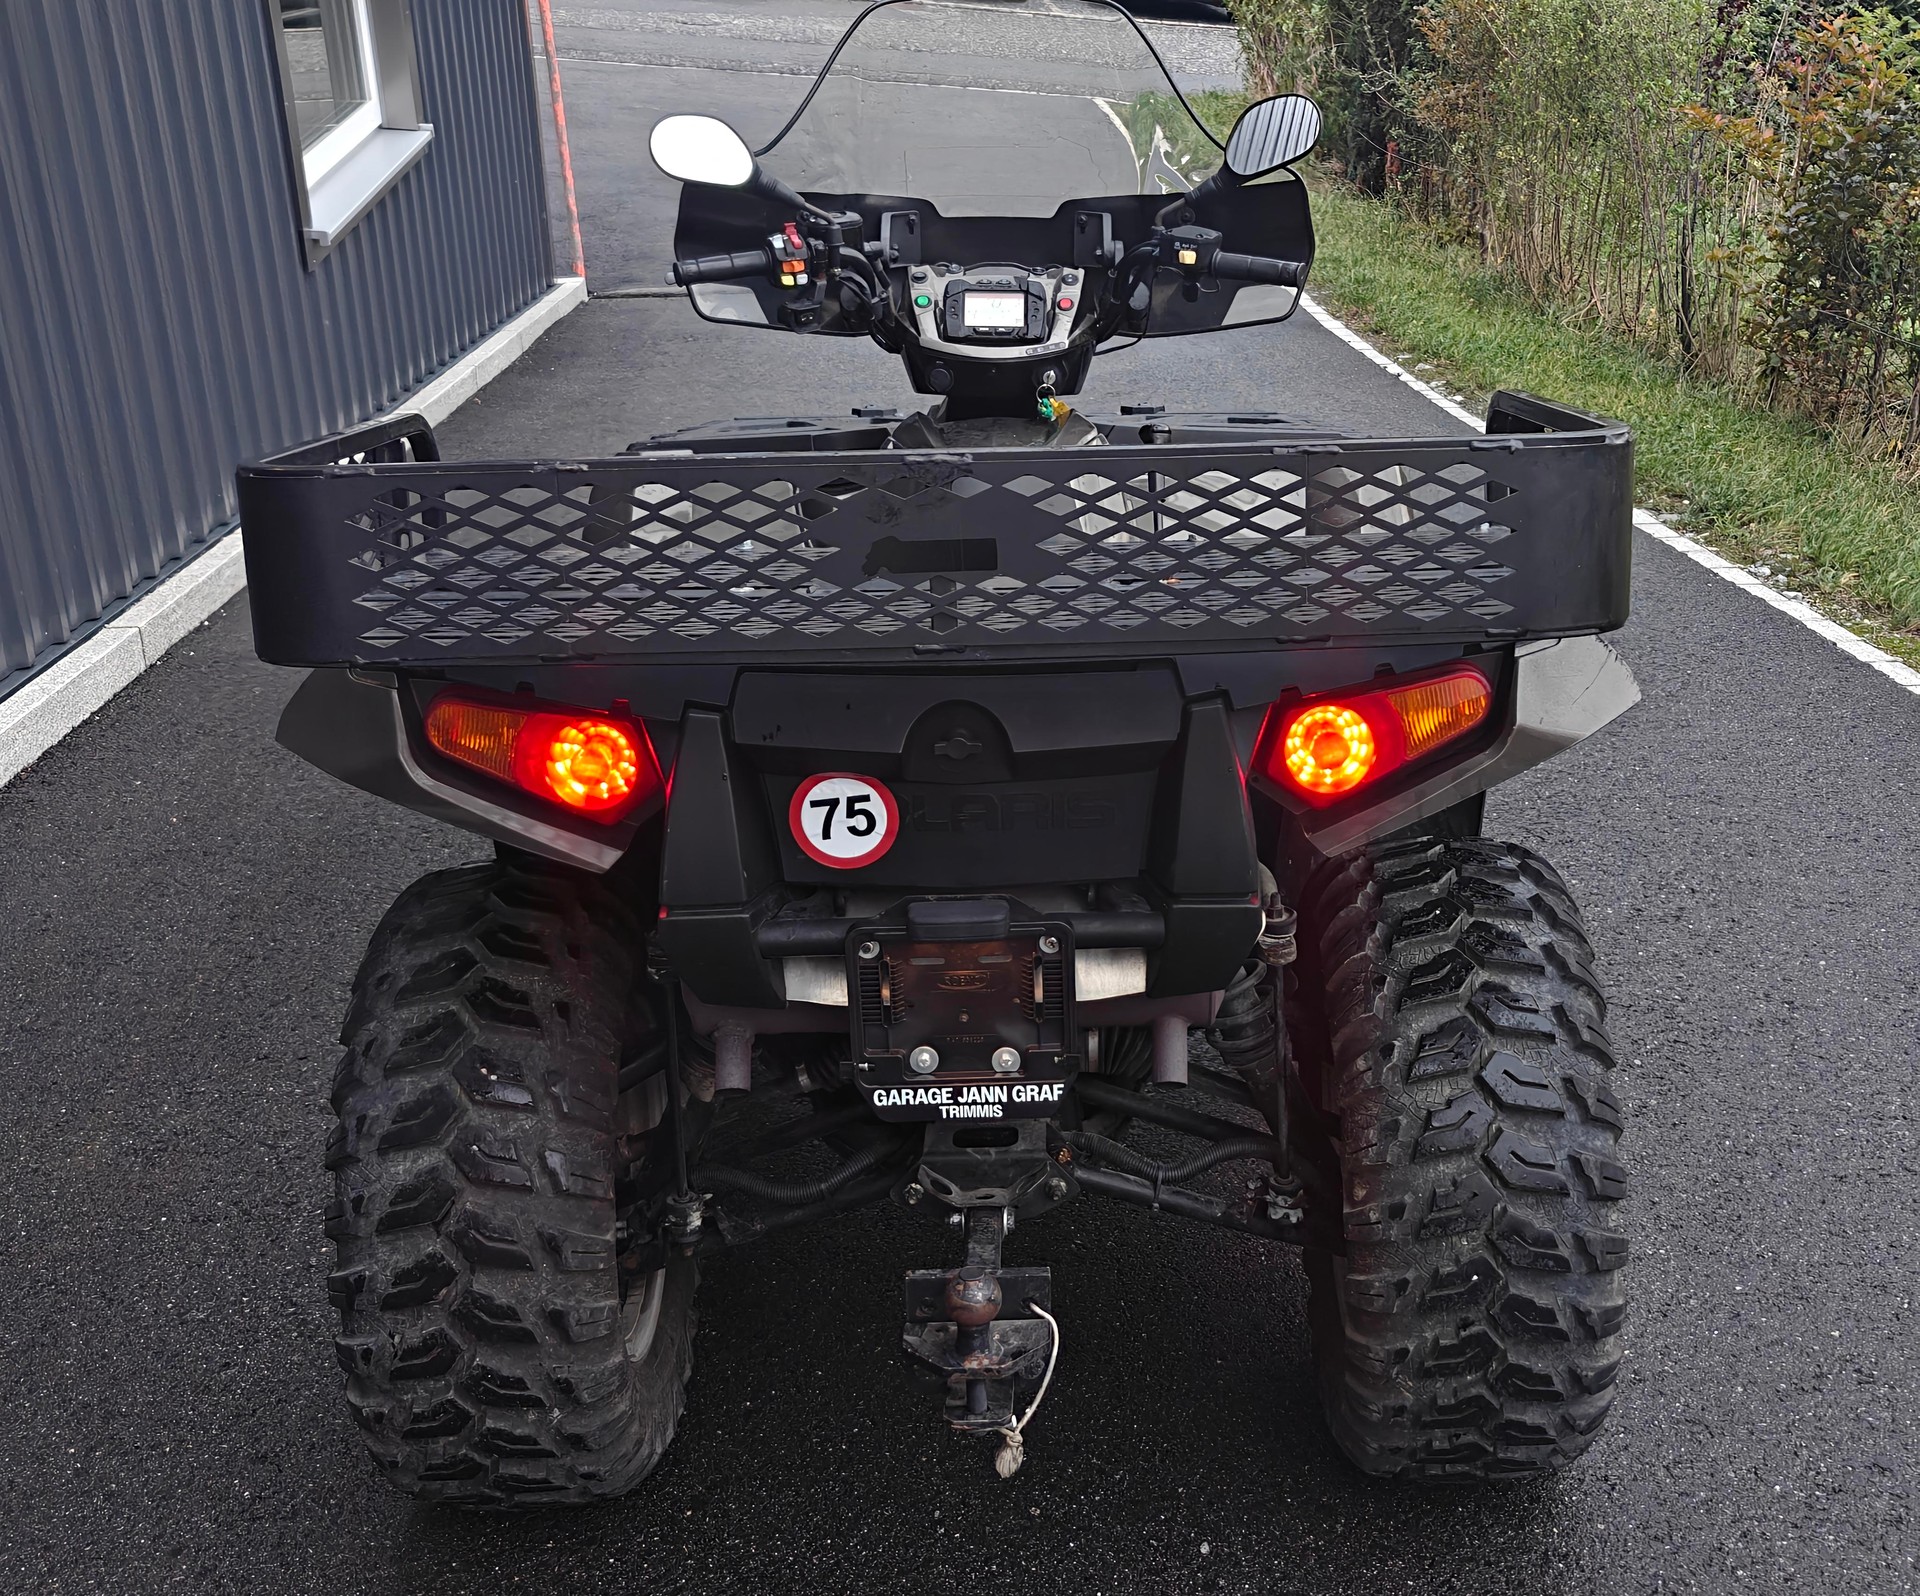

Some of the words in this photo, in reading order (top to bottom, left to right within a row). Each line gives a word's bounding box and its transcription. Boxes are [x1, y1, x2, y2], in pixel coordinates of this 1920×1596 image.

[809, 794, 877, 841] 75
[873, 1086, 954, 1107] GARAGE
[957, 1085, 1008, 1104] JANN
[1011, 1083, 1065, 1103] GRAF
[938, 1104, 1004, 1119] TRIMMIS
